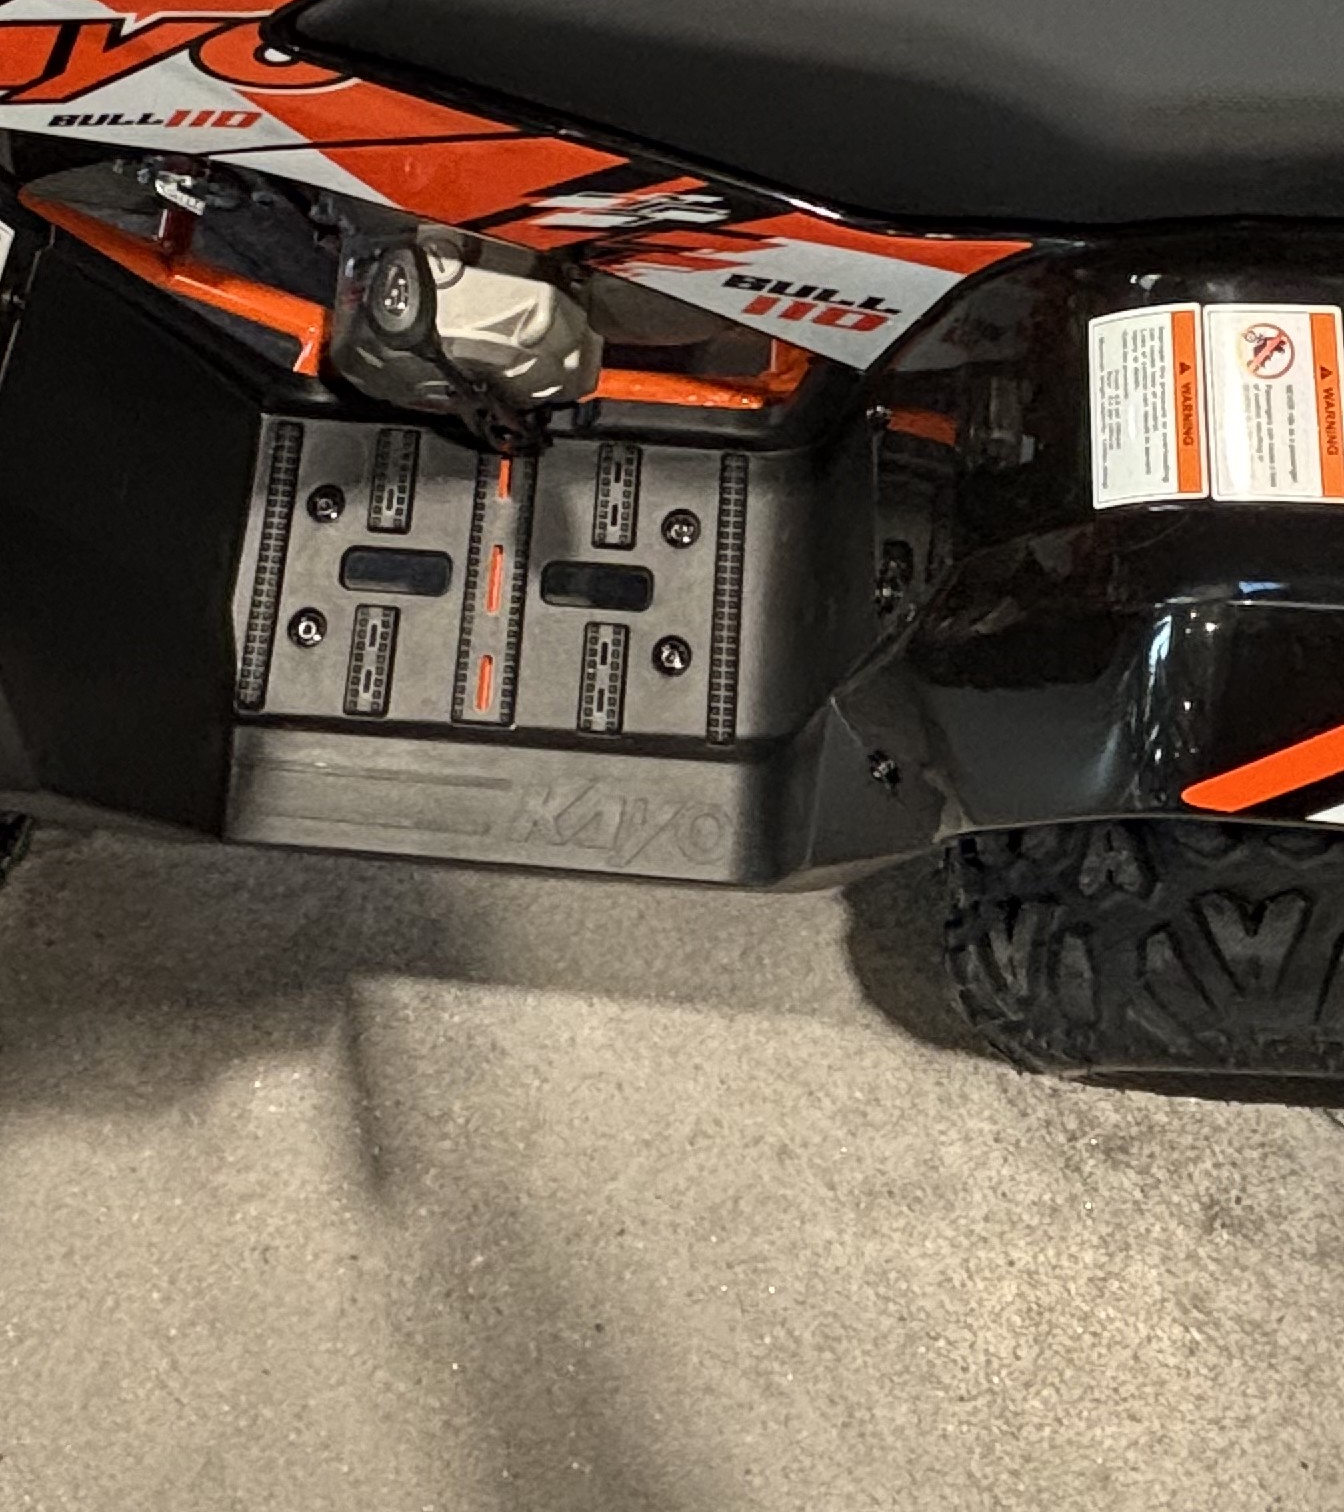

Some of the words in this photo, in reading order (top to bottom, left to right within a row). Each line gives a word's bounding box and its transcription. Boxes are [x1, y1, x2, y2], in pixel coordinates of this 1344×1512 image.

[721, 272, 903, 315] BULL
[742, 295, 894, 333] 110
[1180, 382, 1194, 445] WARNING
[1321, 386, 1338, 455] WARNING
